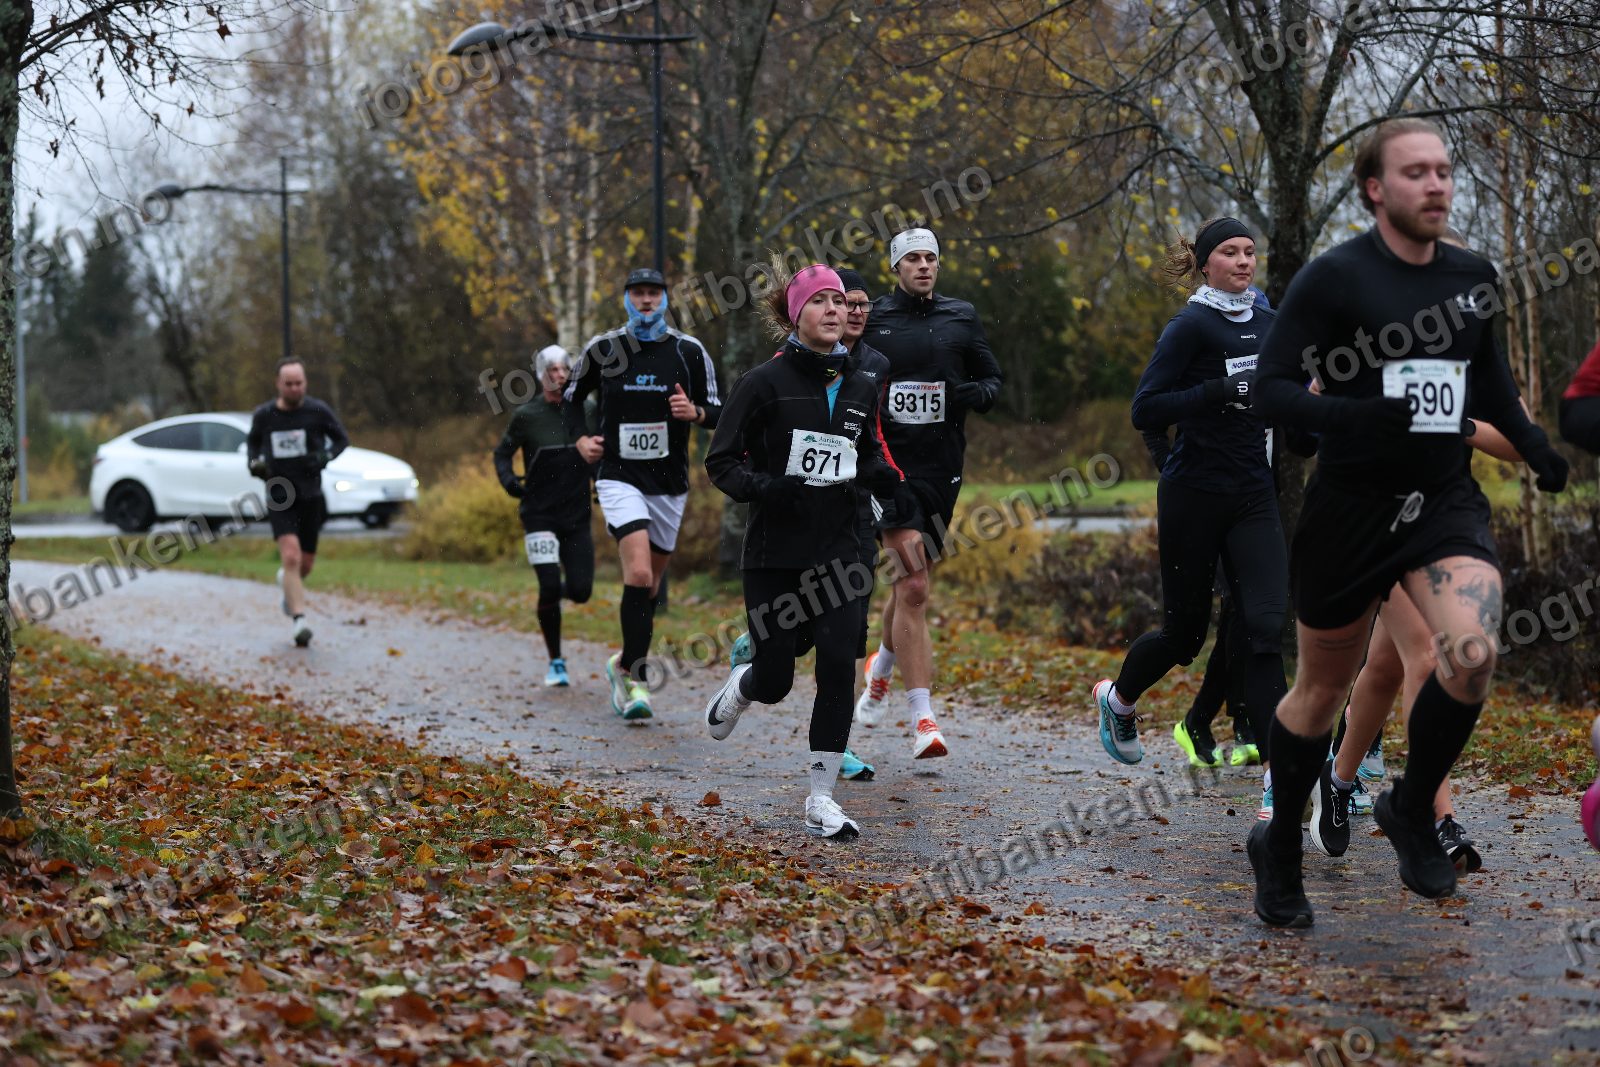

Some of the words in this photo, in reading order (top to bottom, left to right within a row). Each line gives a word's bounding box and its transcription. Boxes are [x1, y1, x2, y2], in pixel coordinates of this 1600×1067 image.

[894, 392, 941, 413] 9315
[1405, 381, 1454, 416] 590
[629, 433, 659, 451] 402
[801, 447, 842, 477] 671
